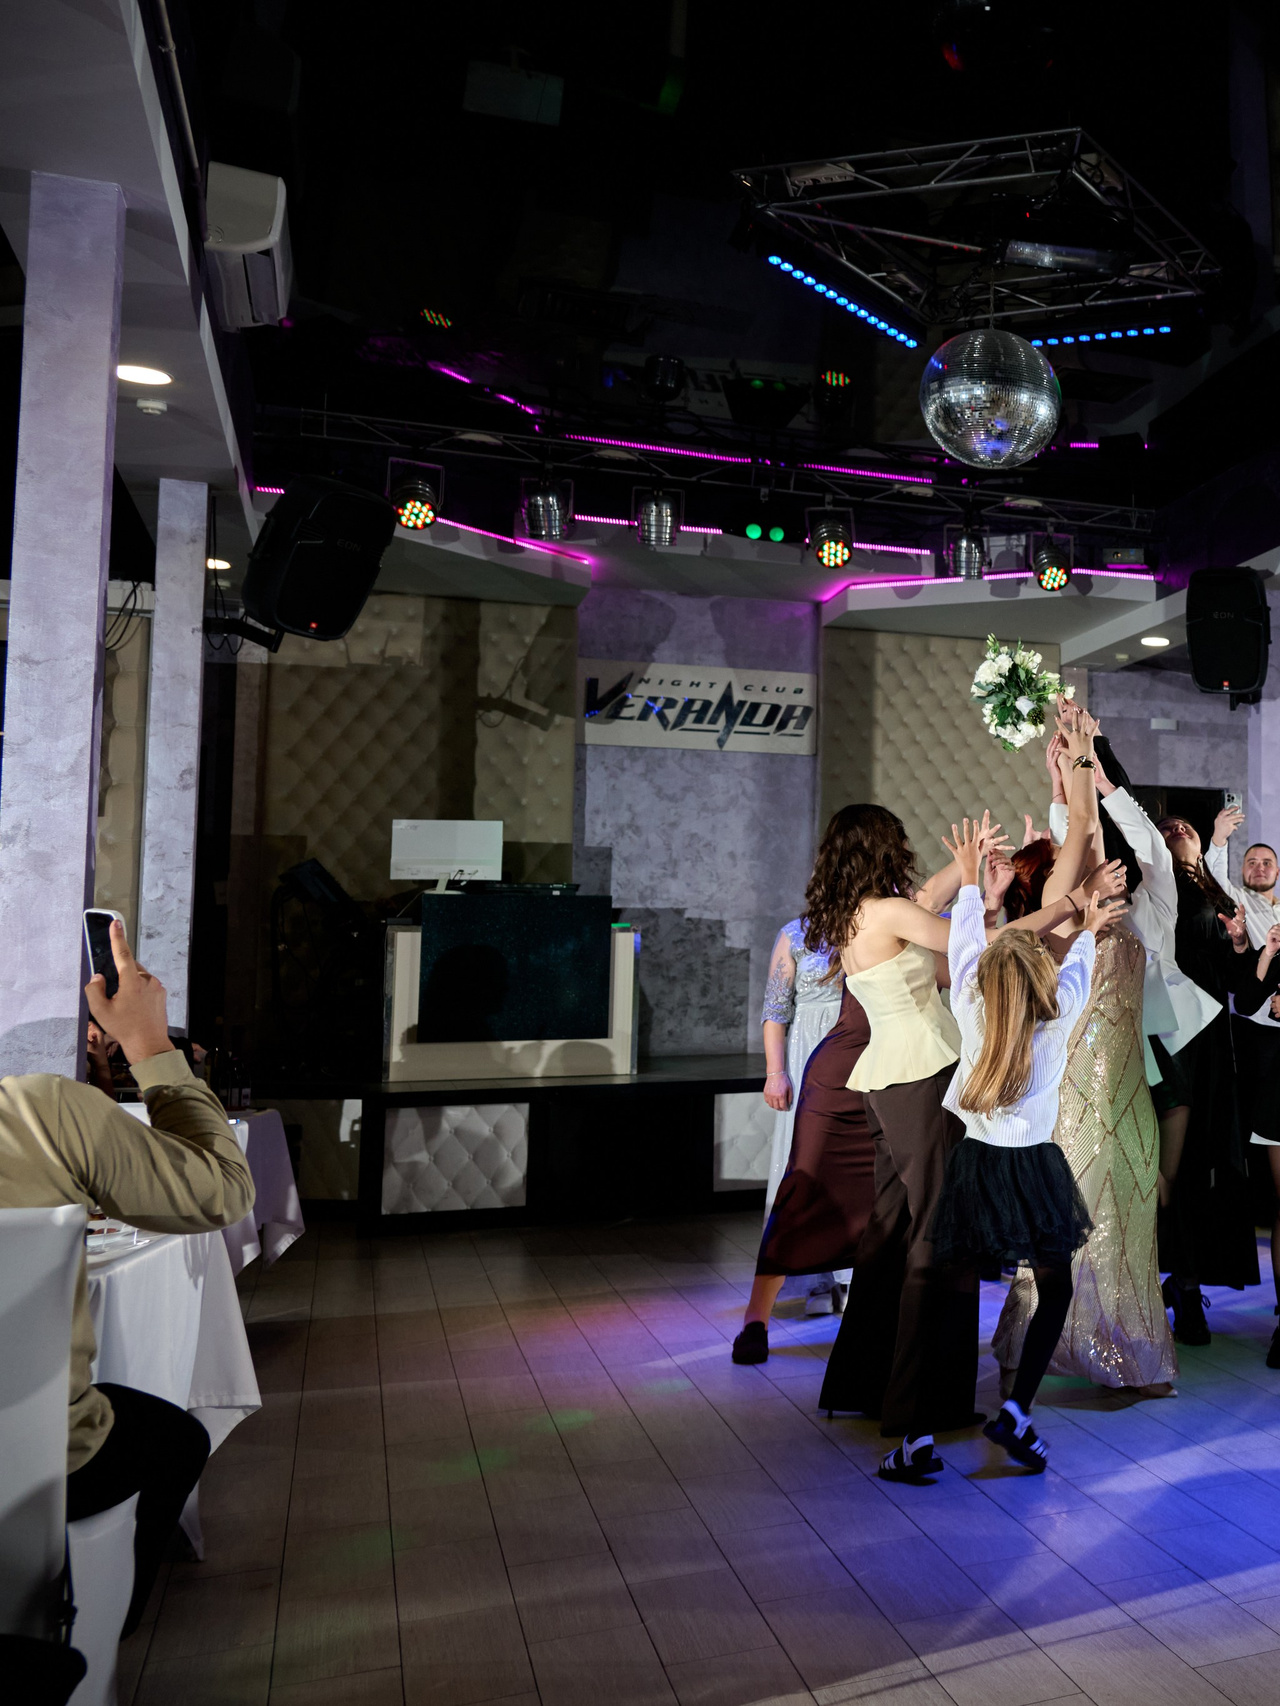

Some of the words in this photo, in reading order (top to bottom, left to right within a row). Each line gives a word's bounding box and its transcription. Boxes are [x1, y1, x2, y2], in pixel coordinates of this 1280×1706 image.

[638, 677, 718, 689] NIGHT
[743, 684, 804, 694] CLUB
[585, 671, 814, 750] VERANDA
